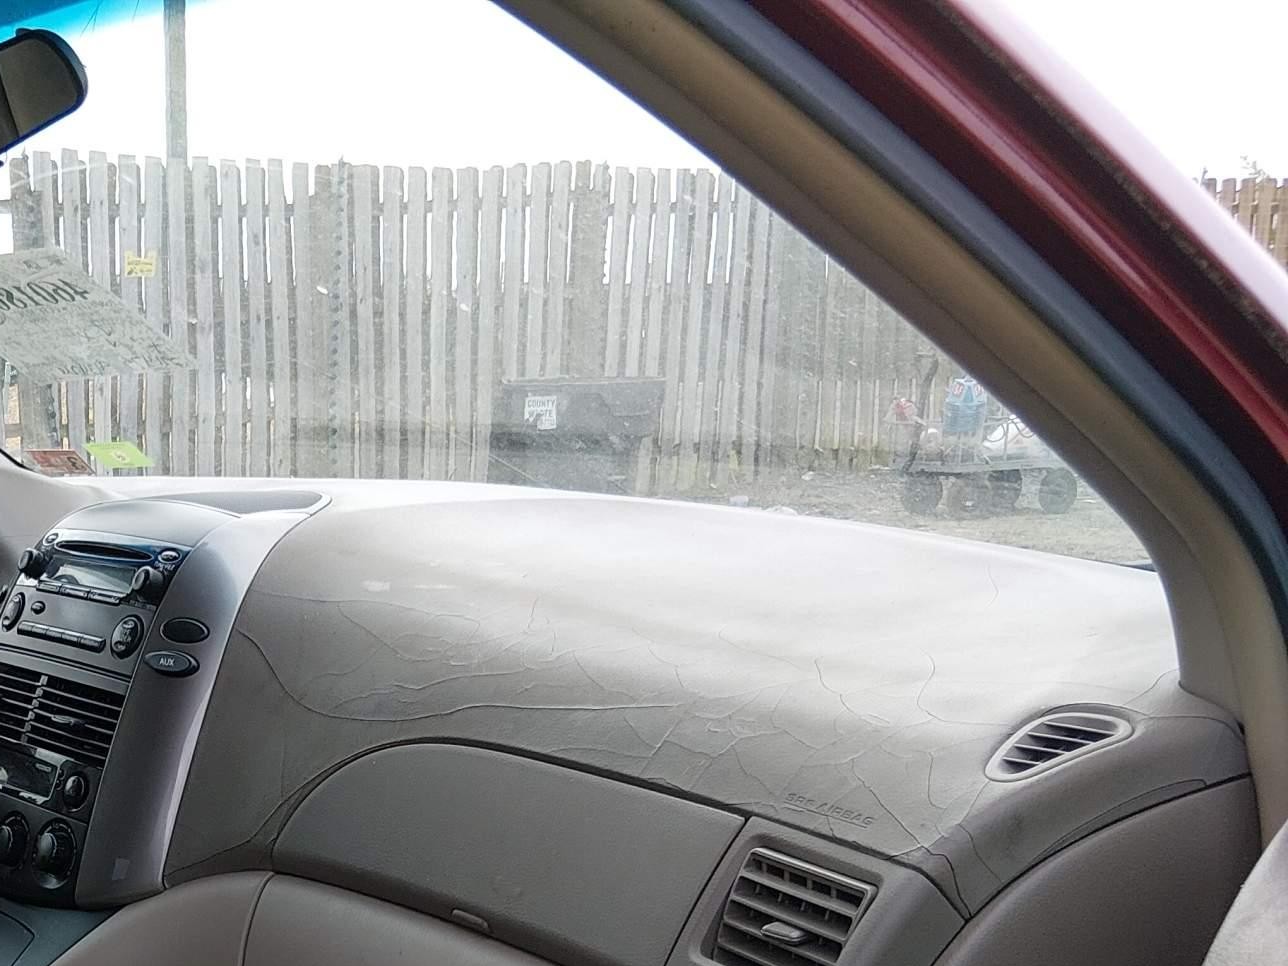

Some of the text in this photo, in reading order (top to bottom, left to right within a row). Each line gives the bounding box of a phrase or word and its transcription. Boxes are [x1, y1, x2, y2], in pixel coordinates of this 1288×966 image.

[527, 399, 556, 409] COUNTY
[159, 657, 175, 667] AUX
[815, 801, 874, 825] AIRBAG
